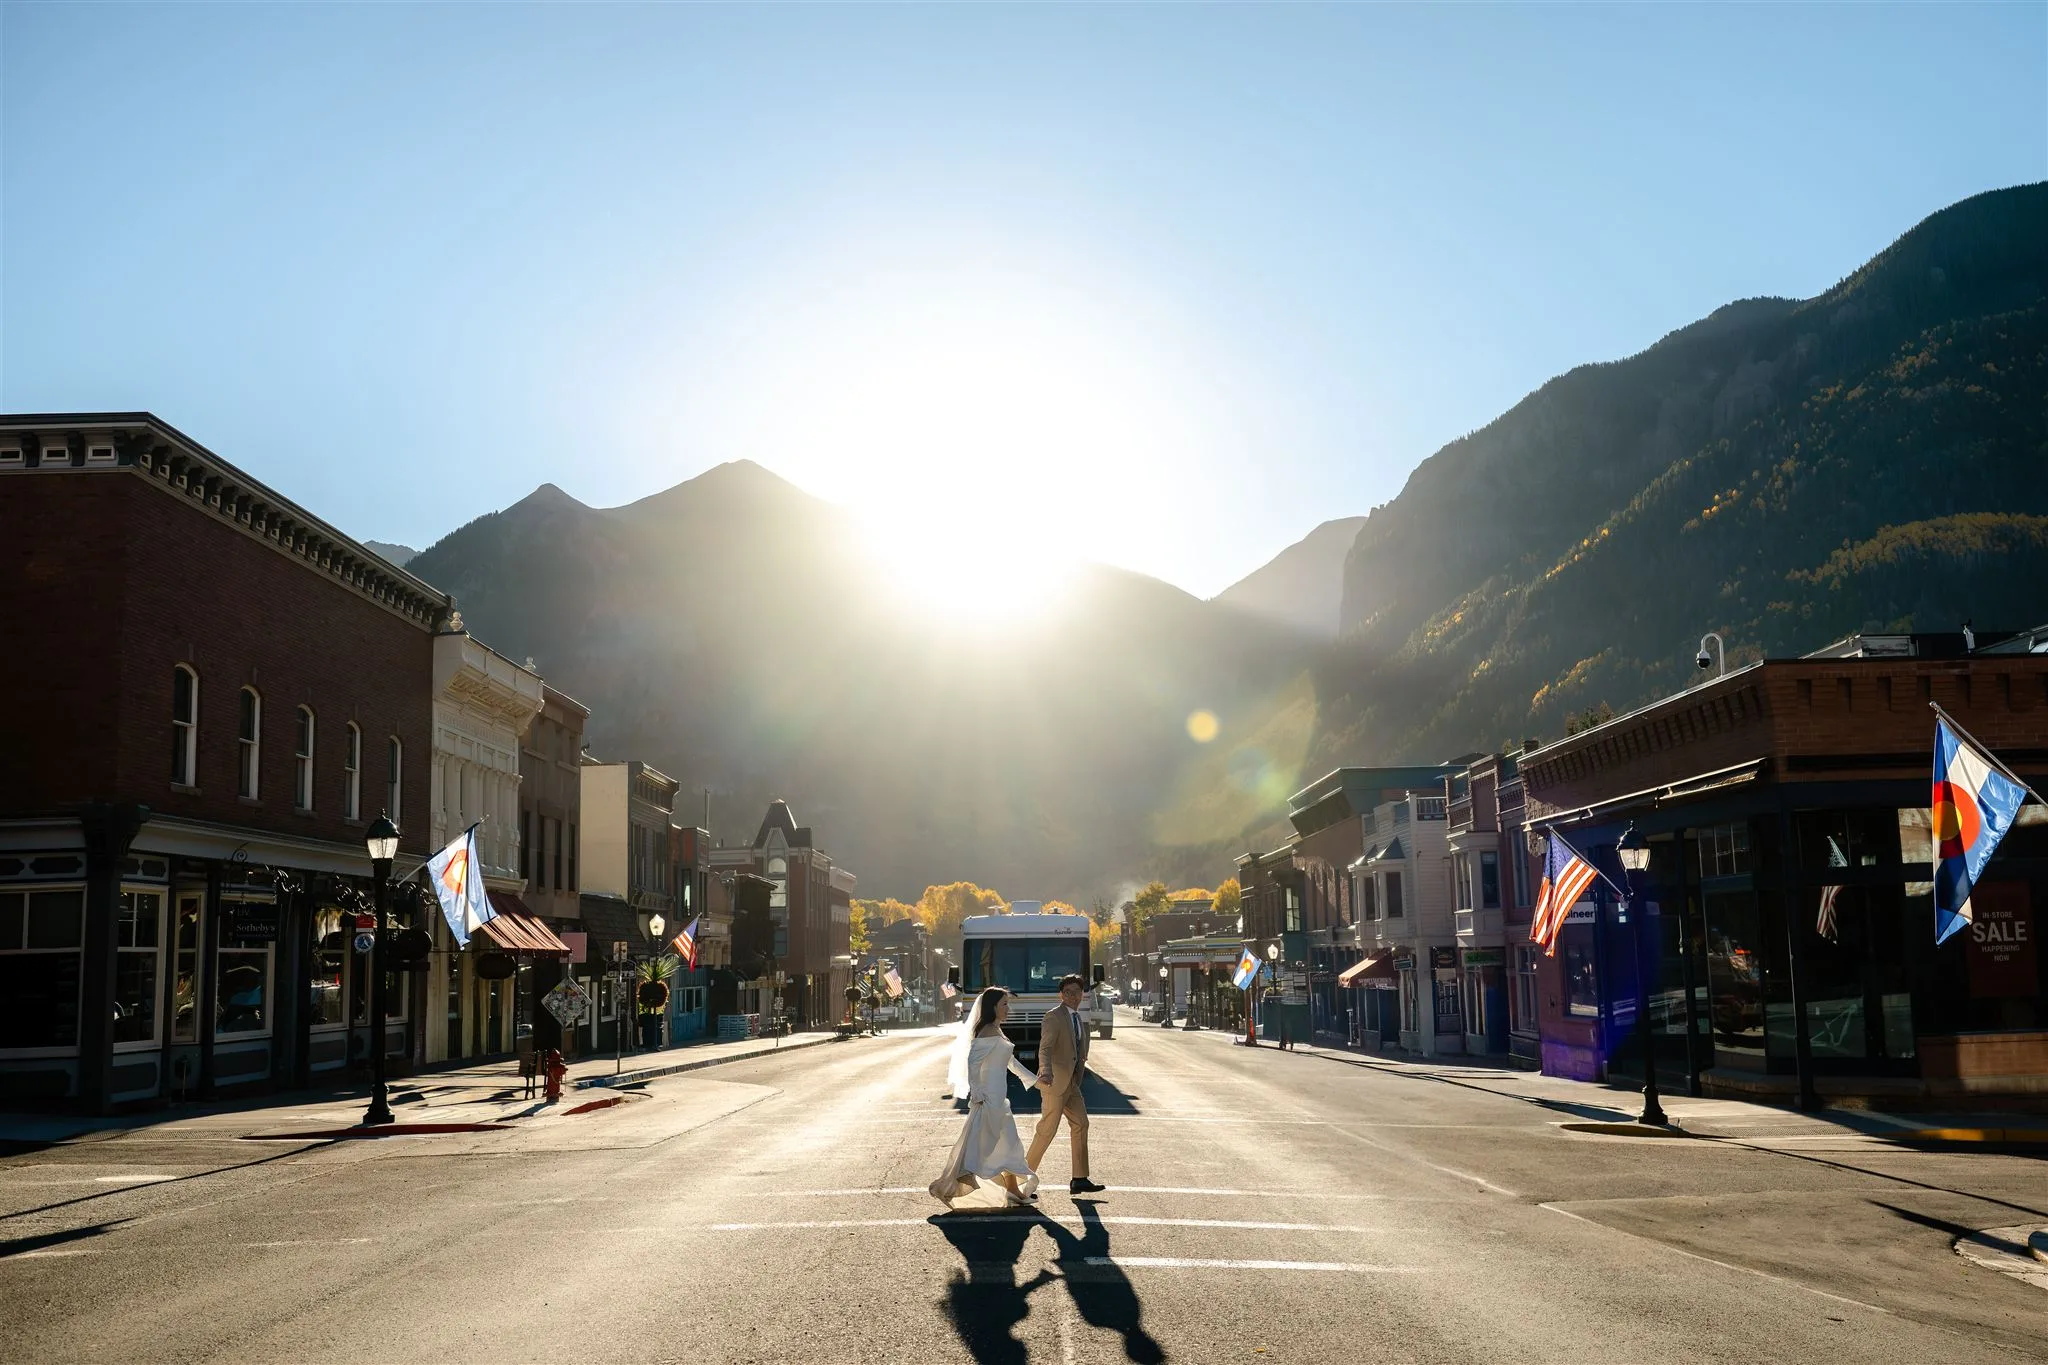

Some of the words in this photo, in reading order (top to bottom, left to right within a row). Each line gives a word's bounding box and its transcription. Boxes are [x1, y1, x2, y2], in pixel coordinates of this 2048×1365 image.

[1982, 911, 2014, 919] IN-STORE
[236, 923, 276, 934] Sotheby's
[1972, 920, 2028, 943] SALE
[1981, 944, 2020, 952] HAPPENING
[1993, 954, 2010, 962] NOW
